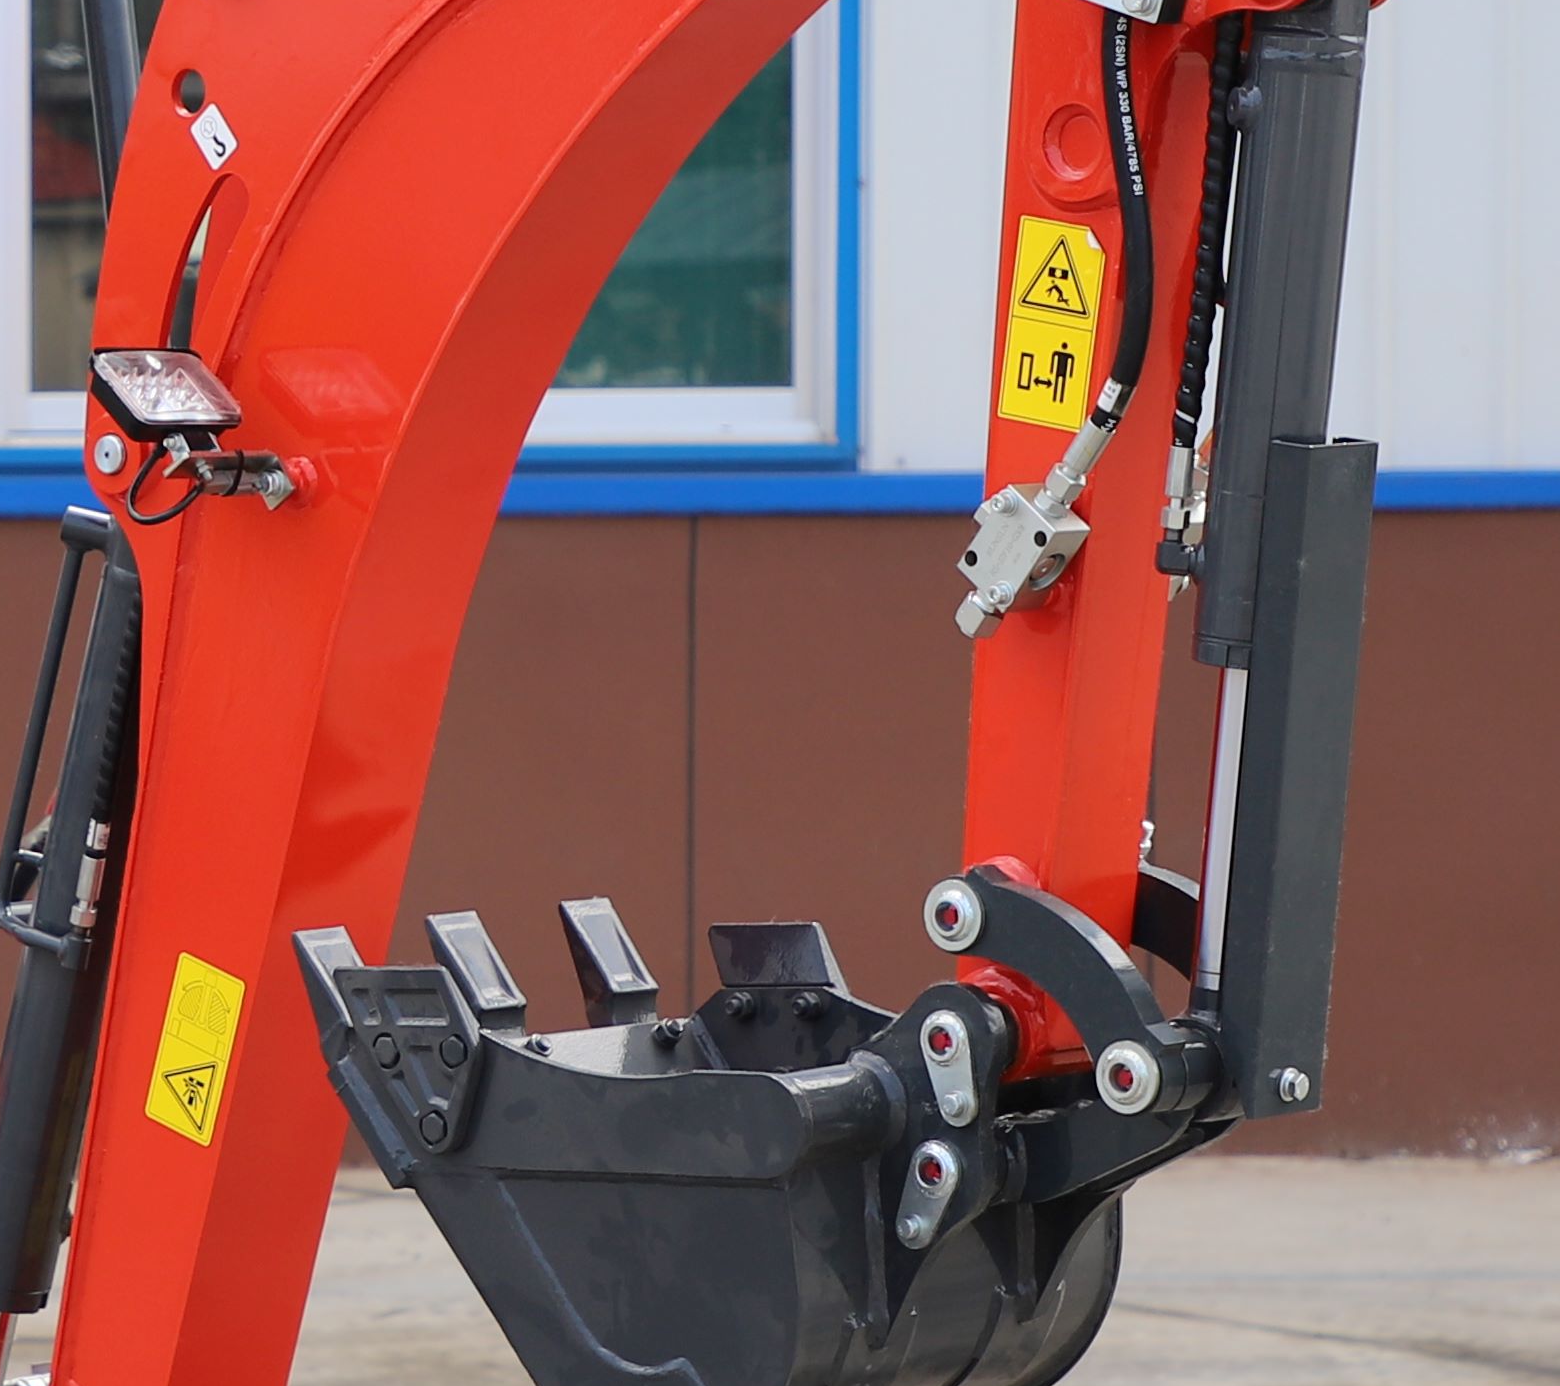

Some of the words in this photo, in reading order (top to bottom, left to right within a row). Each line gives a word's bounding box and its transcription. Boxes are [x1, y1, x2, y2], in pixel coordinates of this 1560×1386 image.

[1114, 34, 1127, 67] (2SN)
[1116, 69, 1128, 89] WP
[1118, 91, 1131, 113] 330
[1121, 115, 1140, 173] BAR/4785
[1130, 175, 1144, 196] PSI
